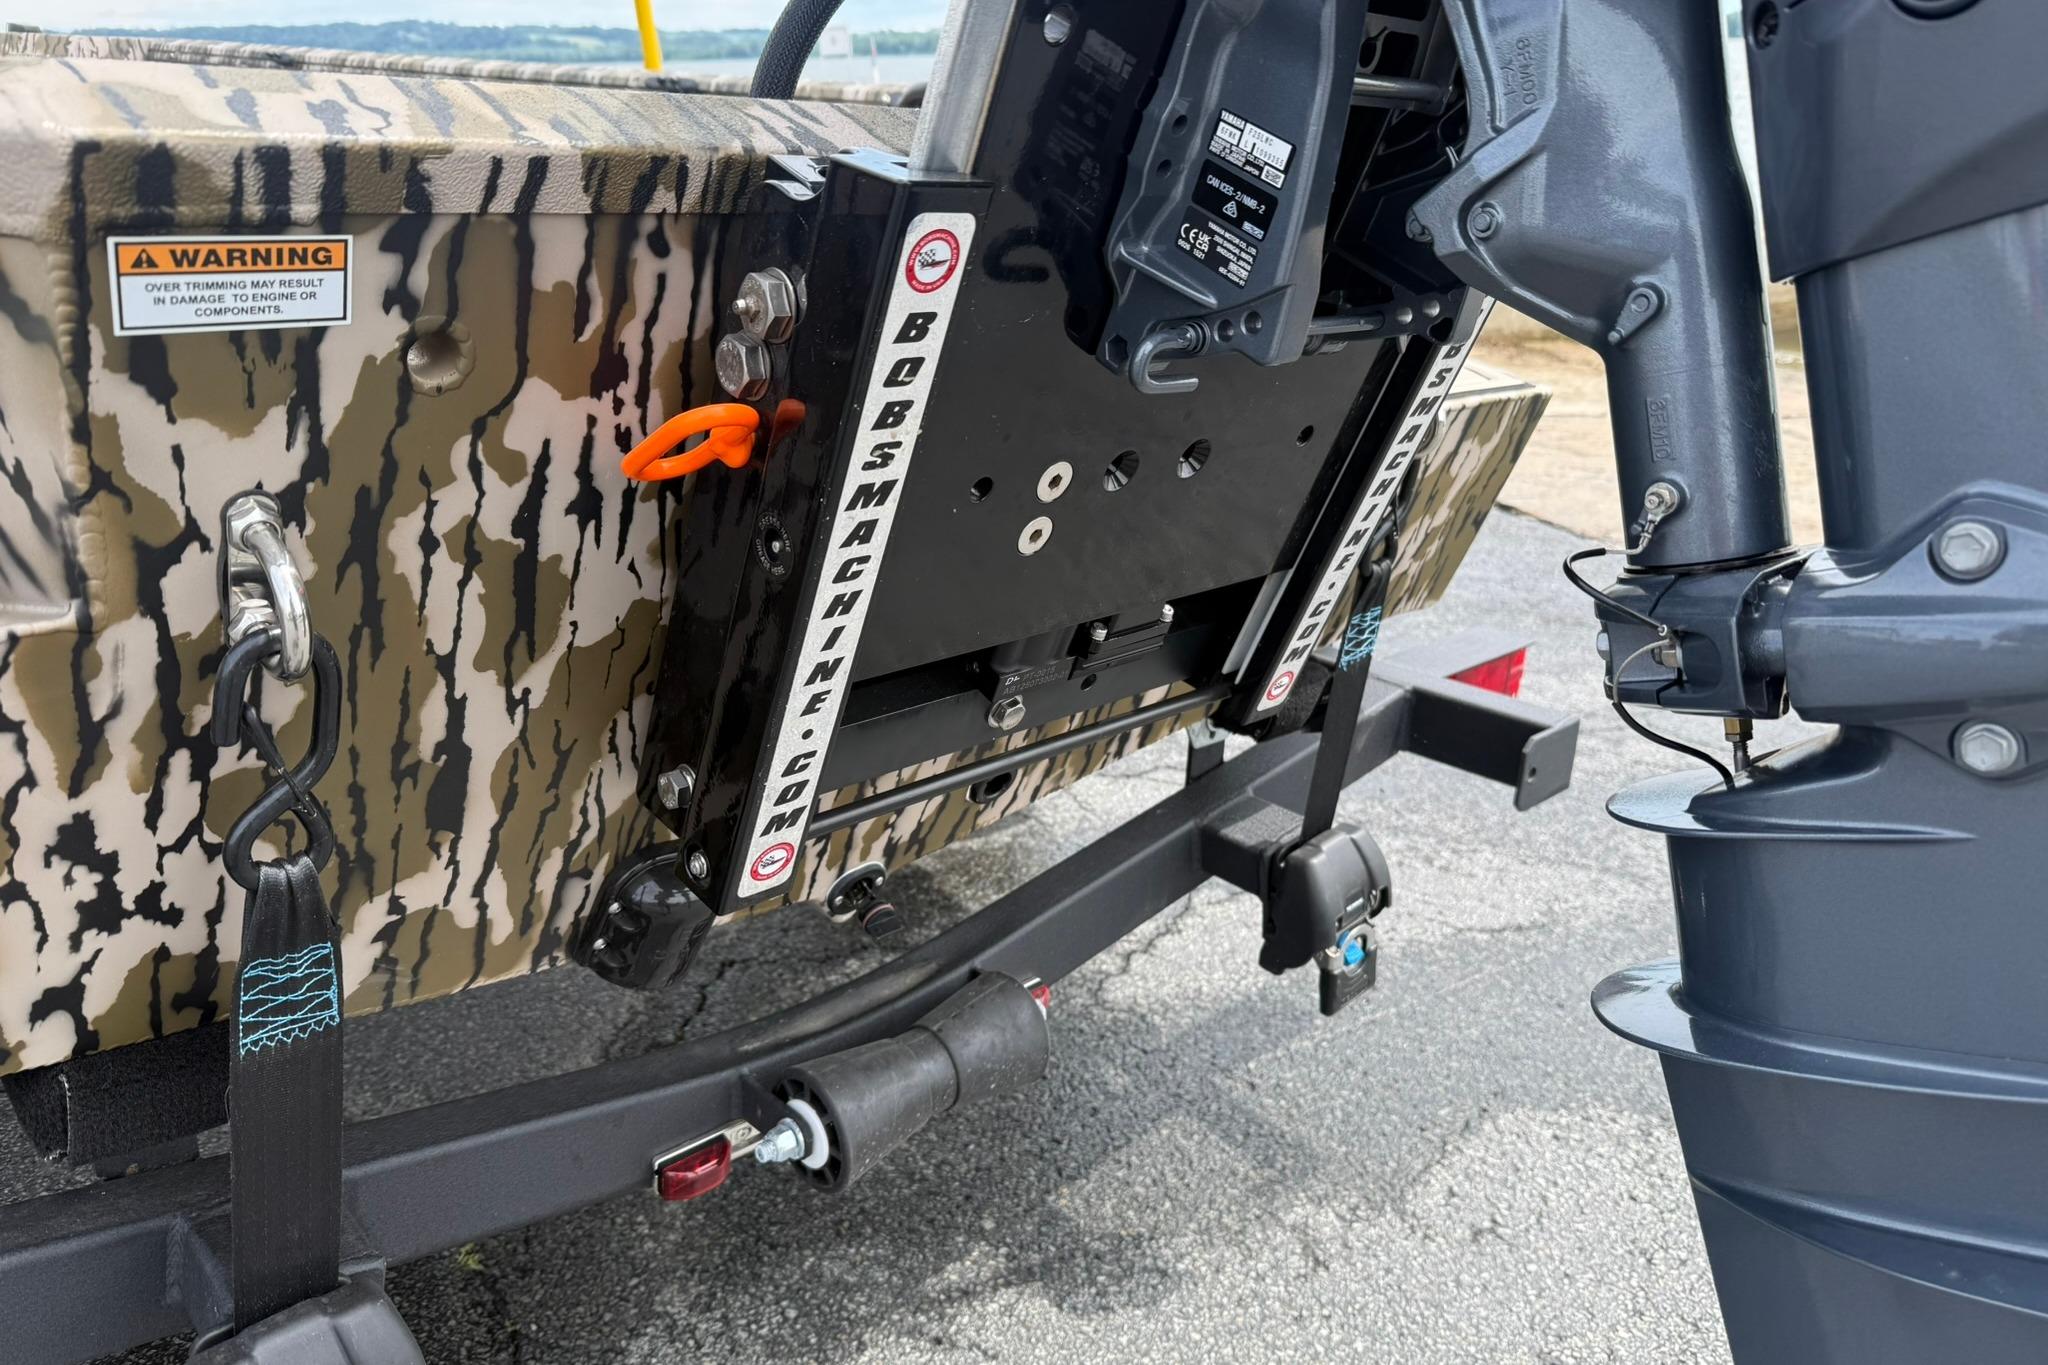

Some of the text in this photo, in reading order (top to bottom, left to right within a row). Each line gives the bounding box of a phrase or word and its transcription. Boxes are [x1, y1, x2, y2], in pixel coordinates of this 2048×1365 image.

[1221, 110, 1245, 129] YAMAHA
[1207, 174, 1266, 215] CAN ICES-2/NMB-2
[169, 246, 333, 268] WARNING
[144, 278, 325, 293] OVER TRIMMING MAY RESULT
[153, 291, 317, 306] IN DAMAGE TO ENGINE OR
[194, 305, 284, 317] COMPONENTS.
[1282, 309, 1484, 665] BSMACHINE.COM
[760, 311, 938, 838] BOBSMACHINE.COM
